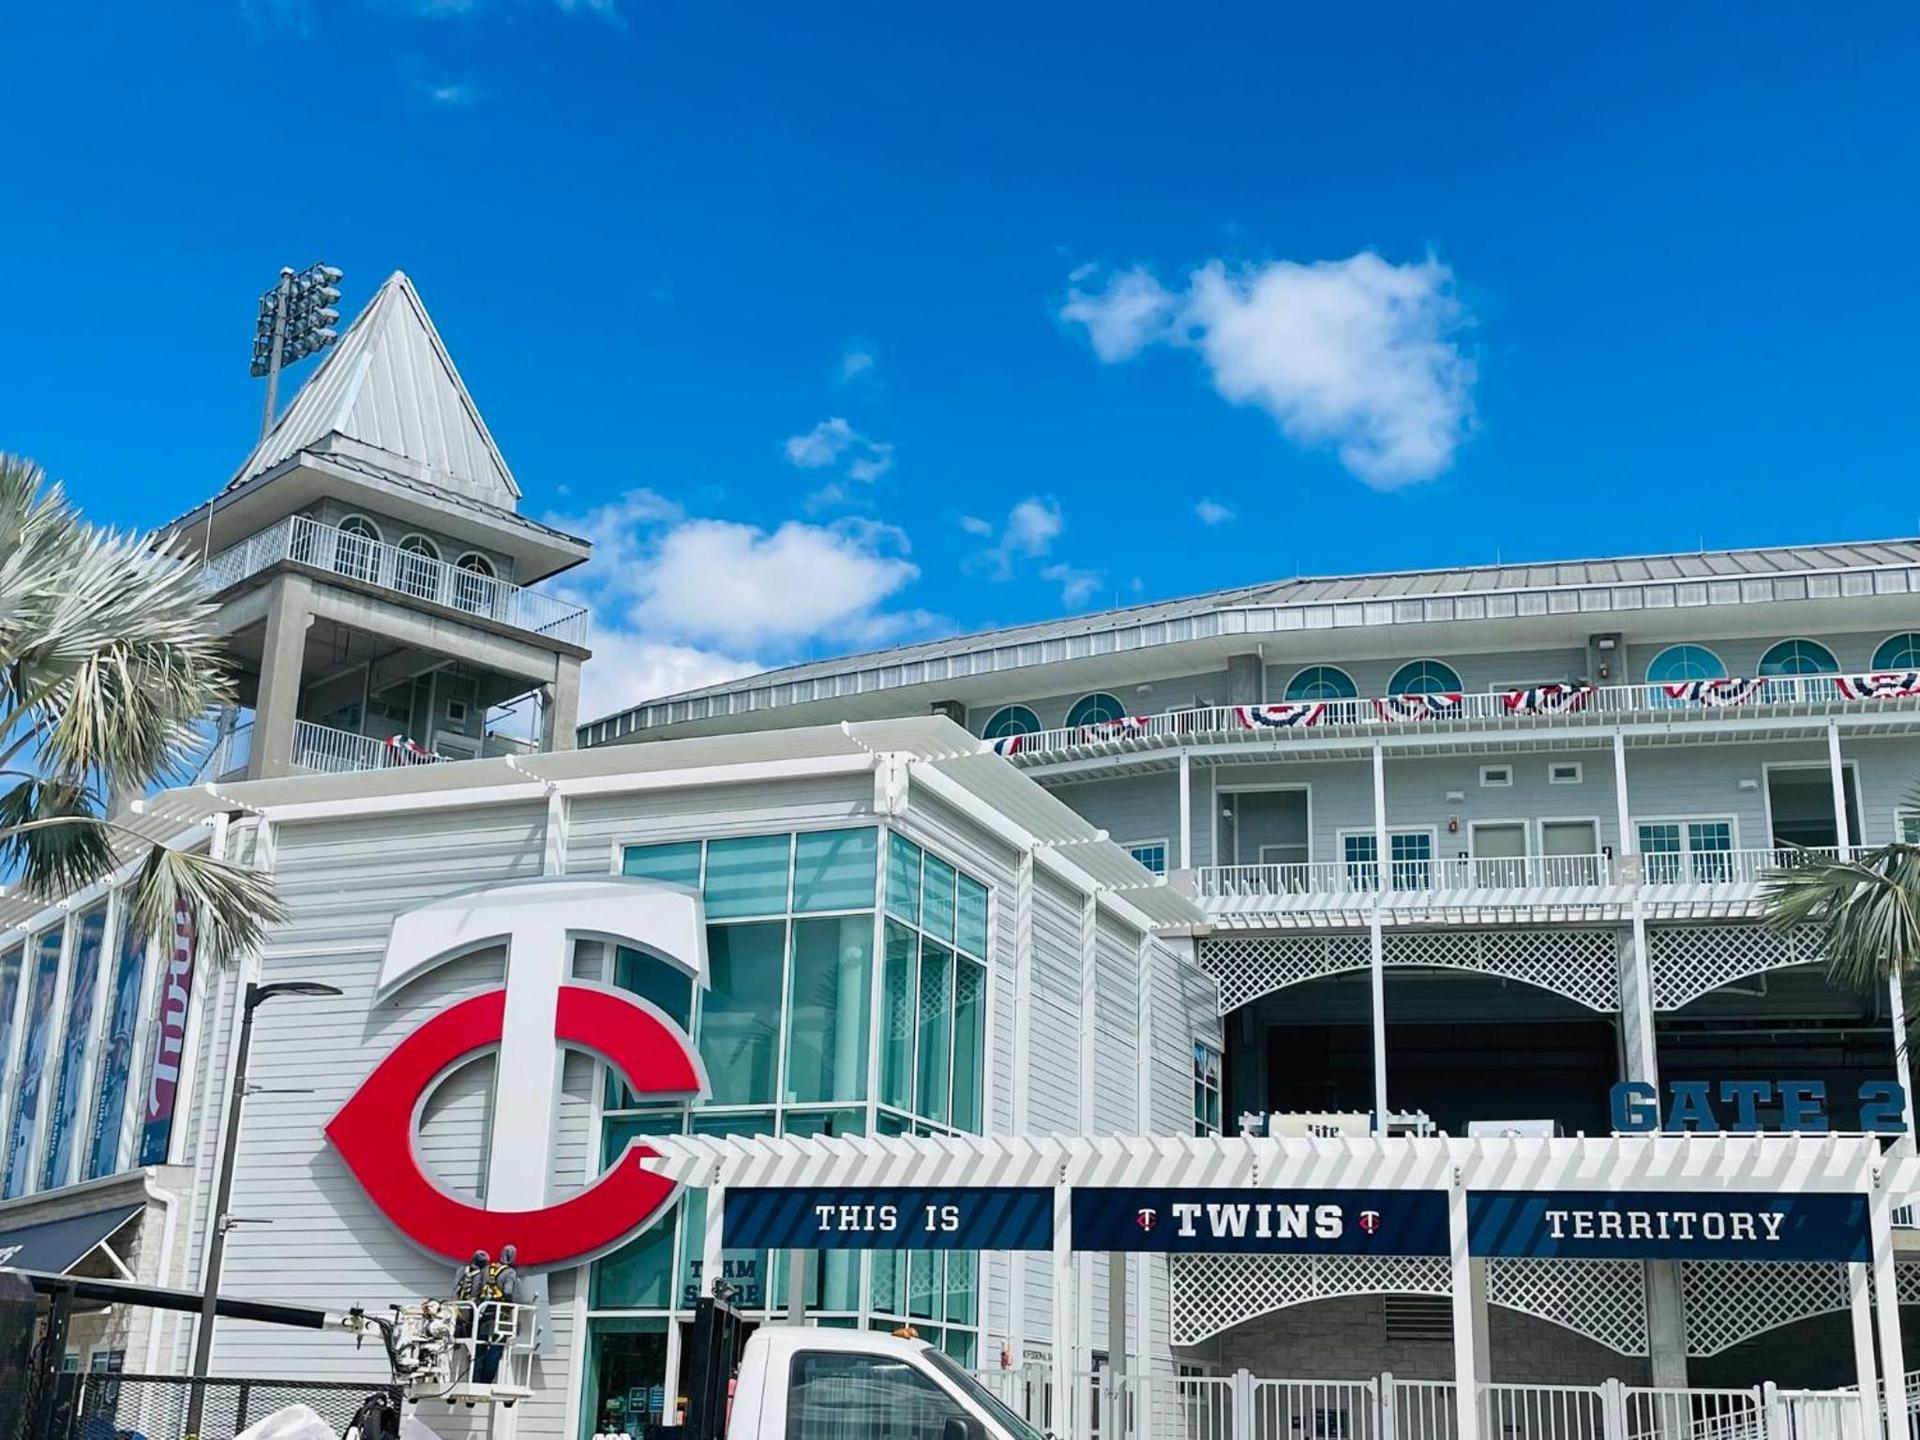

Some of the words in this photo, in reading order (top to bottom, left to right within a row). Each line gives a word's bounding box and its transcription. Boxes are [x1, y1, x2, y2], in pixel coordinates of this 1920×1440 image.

[1610, 1081, 1829, 1133] GATE
[1858, 1080, 1907, 1133] 2
[815, 1205, 897, 1231] THIS
[926, 1205, 959, 1231] IS
[1172, 1203, 1343, 1239] TWINS
[1545, 1211, 1785, 1240] TERRITORY
[690, 1260, 756, 1278] TAM
[684, 1284, 760, 1303] SRE
